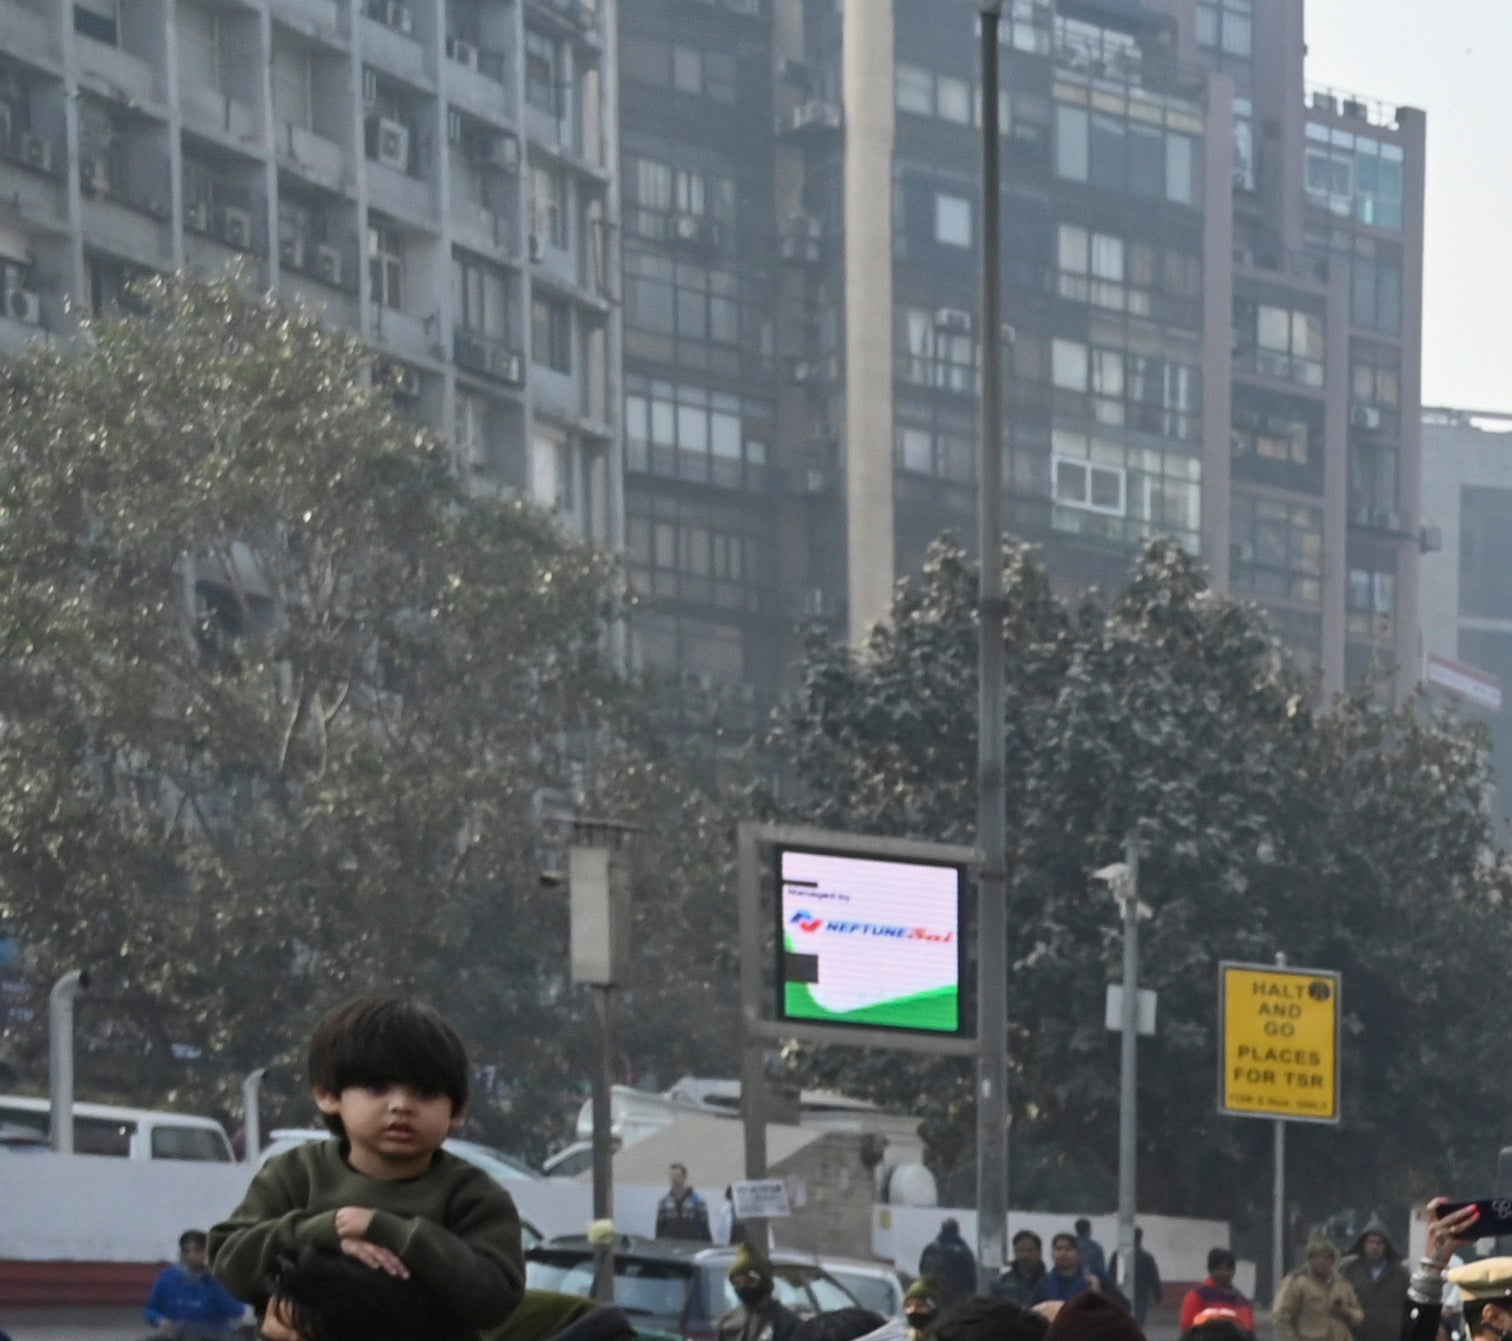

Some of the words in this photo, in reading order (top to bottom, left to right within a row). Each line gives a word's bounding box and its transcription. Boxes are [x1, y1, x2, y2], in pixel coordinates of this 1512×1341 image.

[1252, 981, 1305, 999] HALT
[1258, 1001, 1302, 1019] AND
[1264, 1021, 1295, 1037] GO
[1237, 1044, 1321, 1066] PLACES
[1233, 1066, 1275, 1085] FOR
[1285, 1071, 1323, 1088] TSR
